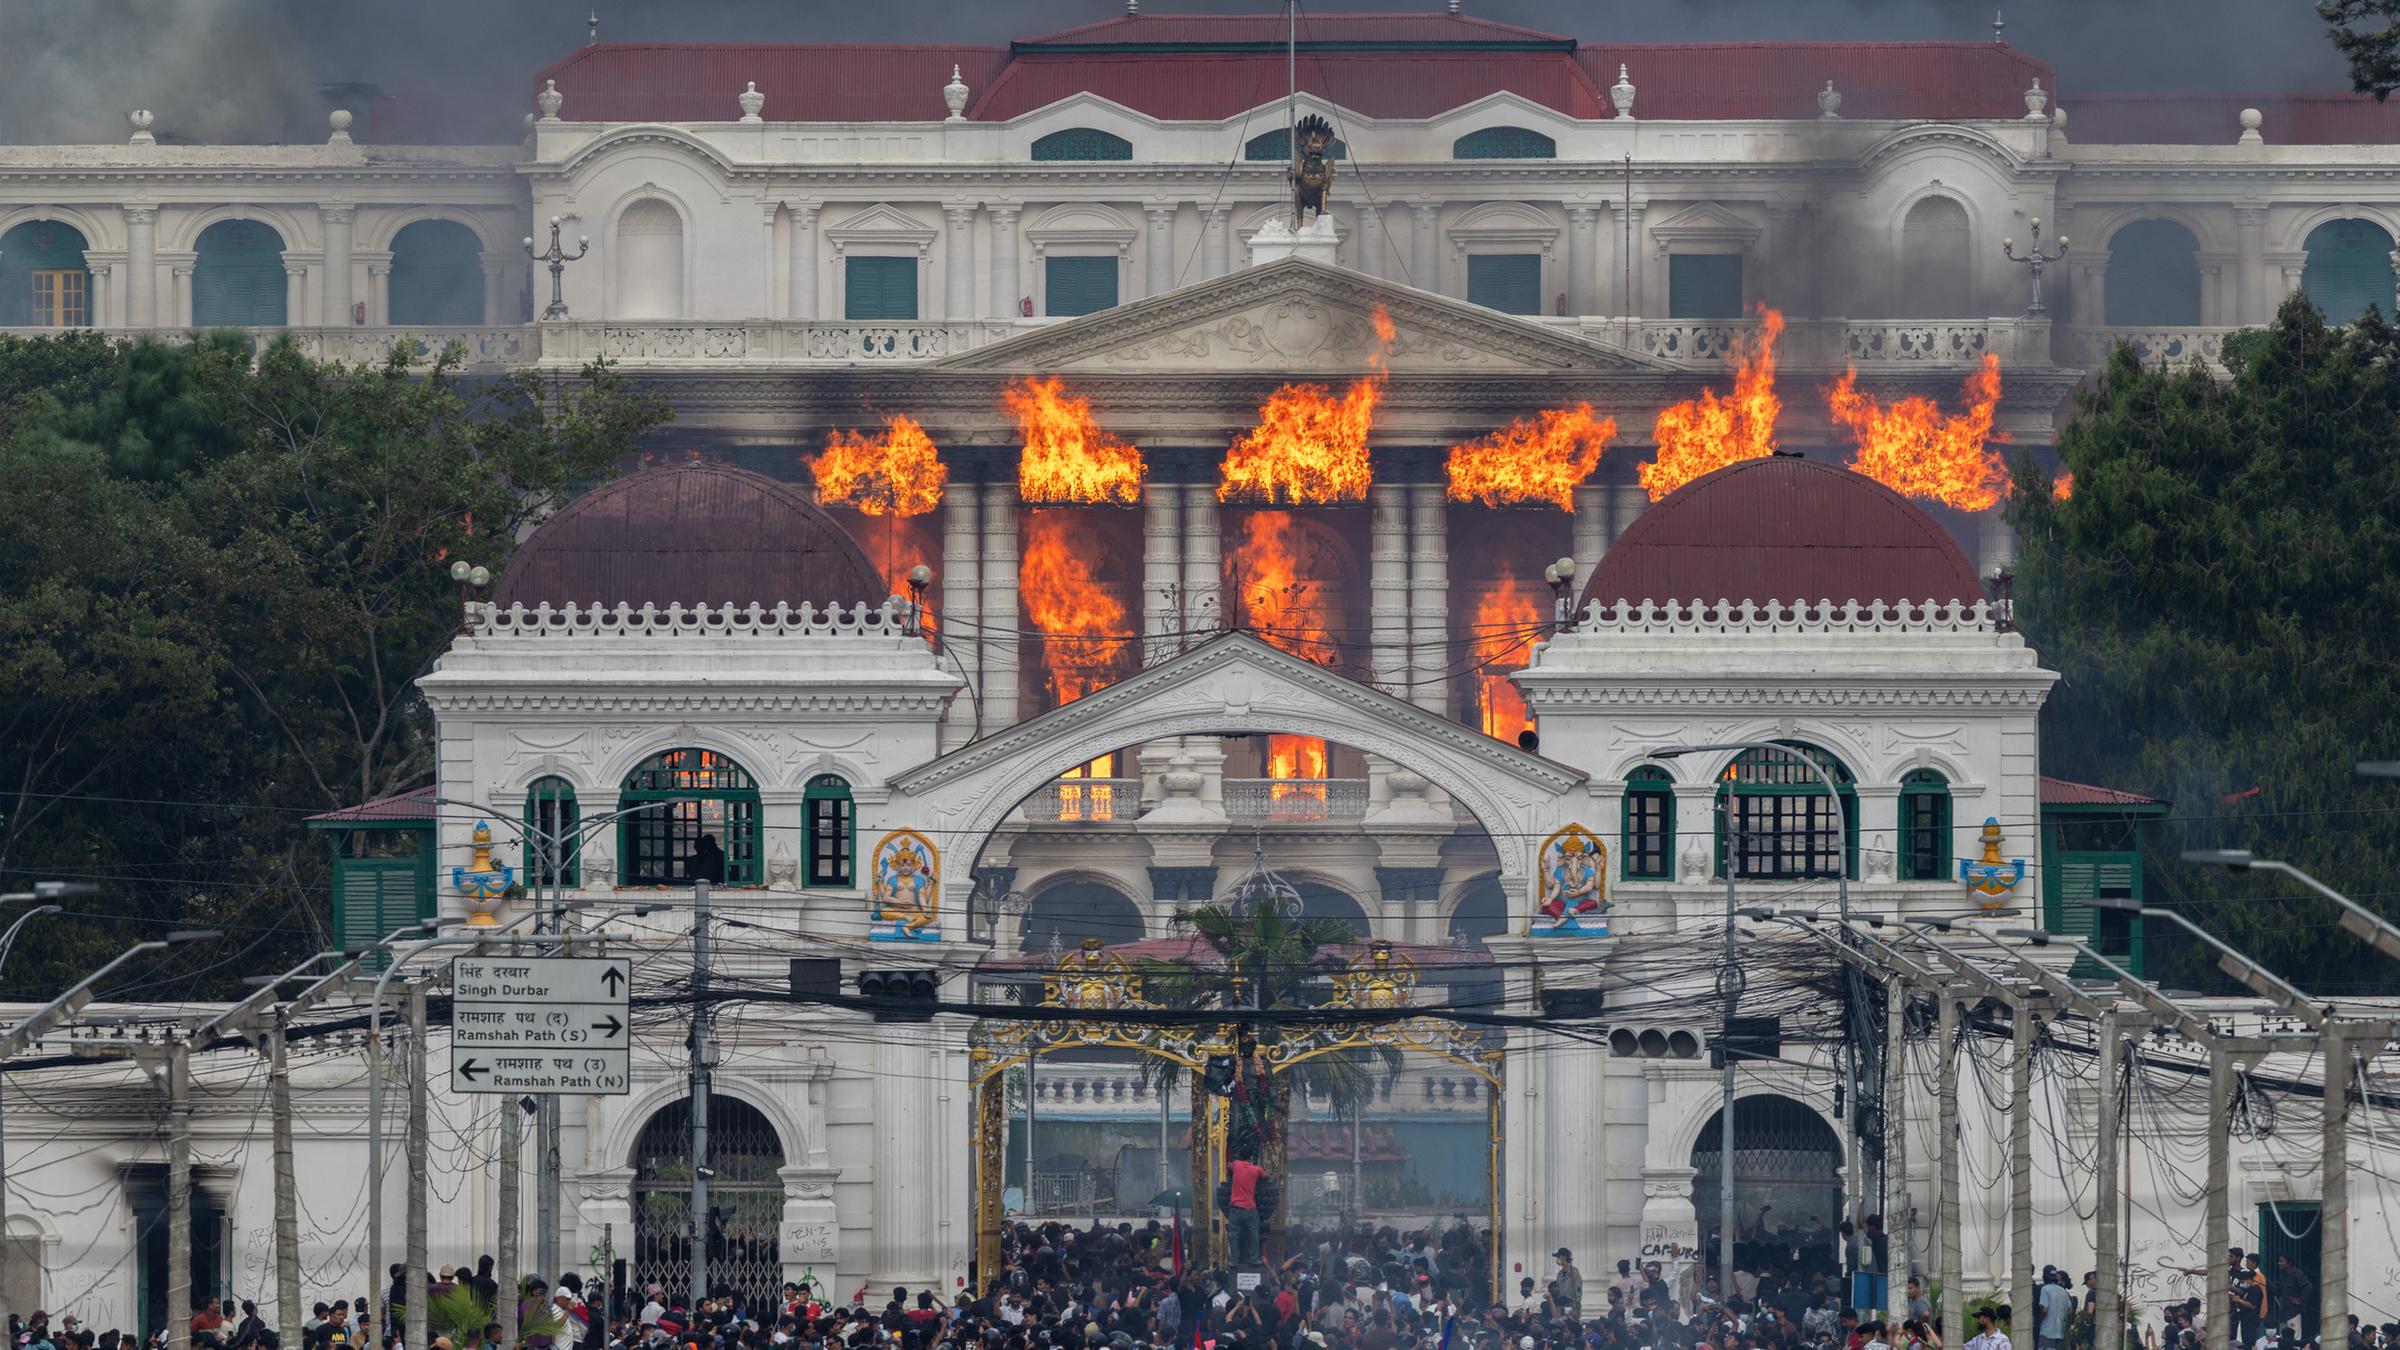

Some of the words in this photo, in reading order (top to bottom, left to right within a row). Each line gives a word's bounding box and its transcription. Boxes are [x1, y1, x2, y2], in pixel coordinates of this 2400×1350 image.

[459, 962, 483, 978] सिंह
[493, 966, 531, 979] दरबार
[458, 984, 497, 997] Singh
[502, 985, 549, 996] Durbar
[458, 1012, 506, 1024] रामशाह
[515, 1012, 536, 1024] पथ
[546, 1012, 569, 1027] (द)
[457, 1030, 519, 1041] Ramshah
[525, 1030, 556, 1041] Path
[561, 1029, 588, 1042] (S)
[495, 1058, 543, 1070] रामशाह
[552, 1058, 573, 1070] पथ
[584, 1058, 606, 1073] (उ)
[493, 1075, 555, 1087] Ramshah
[561, 1076, 591, 1088] Path
[596, 1075, 623, 1088] (N)
